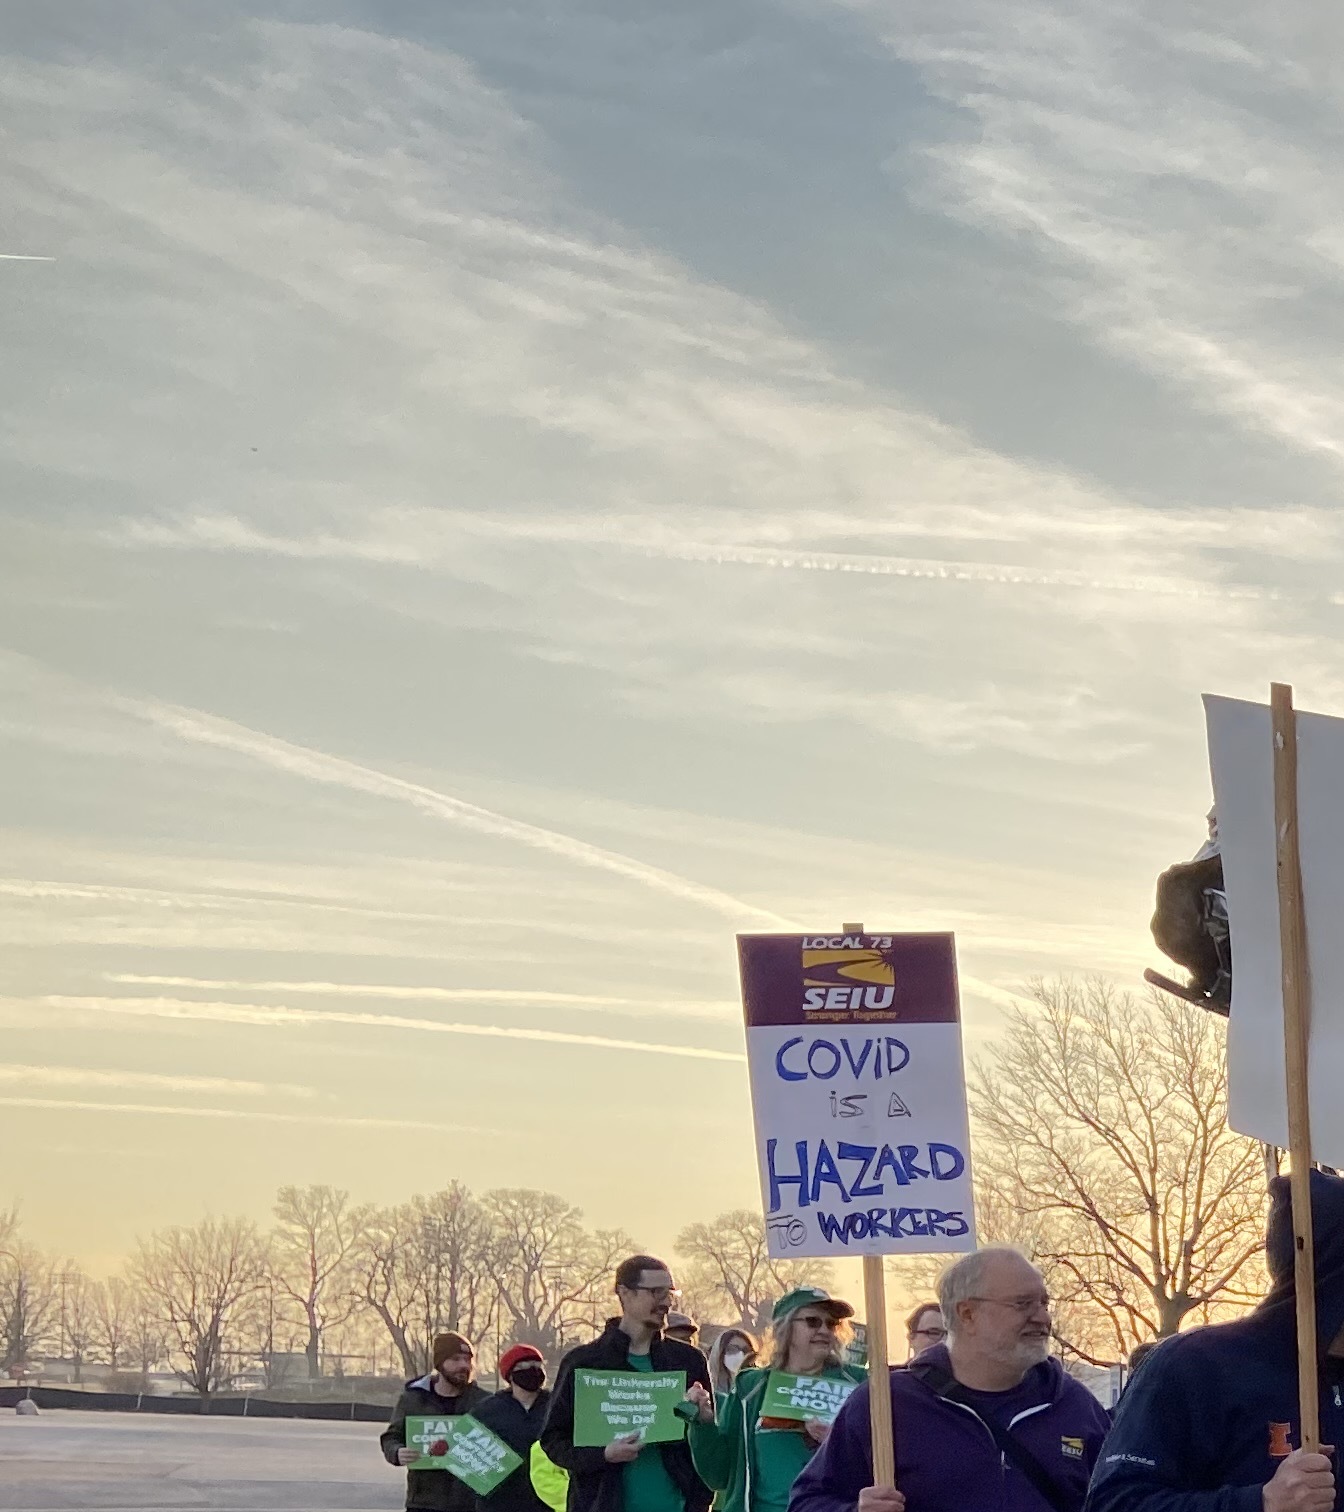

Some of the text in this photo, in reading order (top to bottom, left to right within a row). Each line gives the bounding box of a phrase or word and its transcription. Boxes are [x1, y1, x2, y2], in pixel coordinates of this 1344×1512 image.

[802, 936, 892, 949] LOCAL 73
[802, 986, 895, 1010] SEIU
[887, 1091, 912, 1118] A
[766, 1138, 965, 1213] HAZARD
[767, 1207, 969, 1249] TO WORKERS
